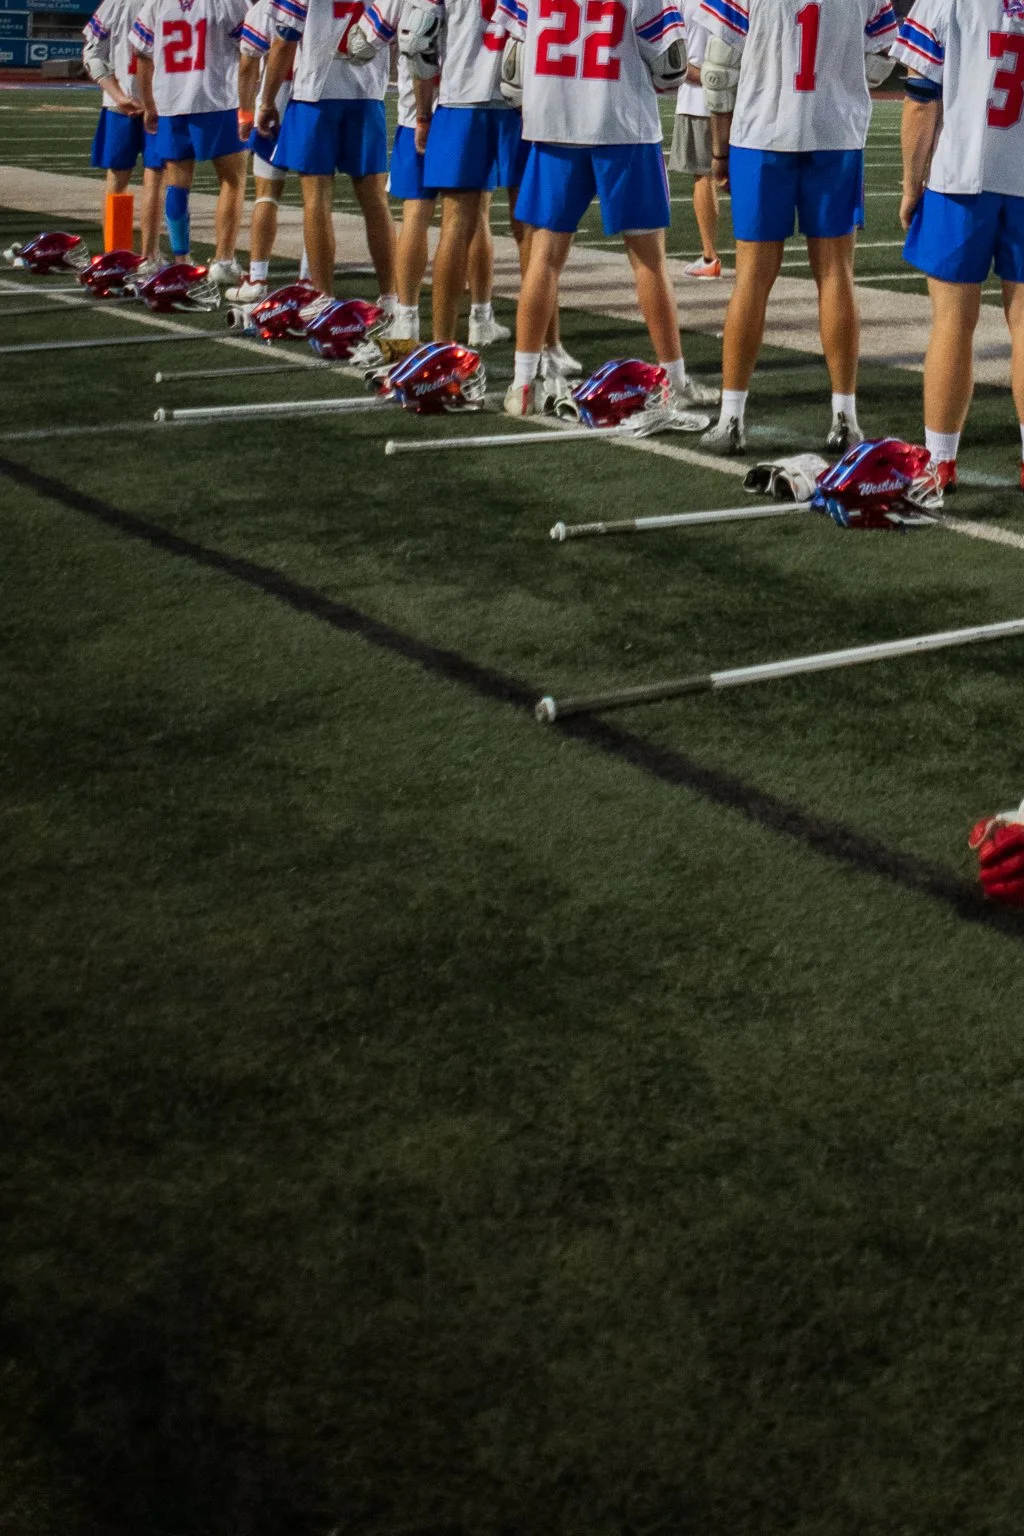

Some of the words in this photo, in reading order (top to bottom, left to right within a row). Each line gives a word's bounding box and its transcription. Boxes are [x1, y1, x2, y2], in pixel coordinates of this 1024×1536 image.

[50, 47, 81, 55] CAPIT
[162, 19, 207, 73] 21
[332, 1, 365, 54] 7
[795, 3, 821, 93] 1
